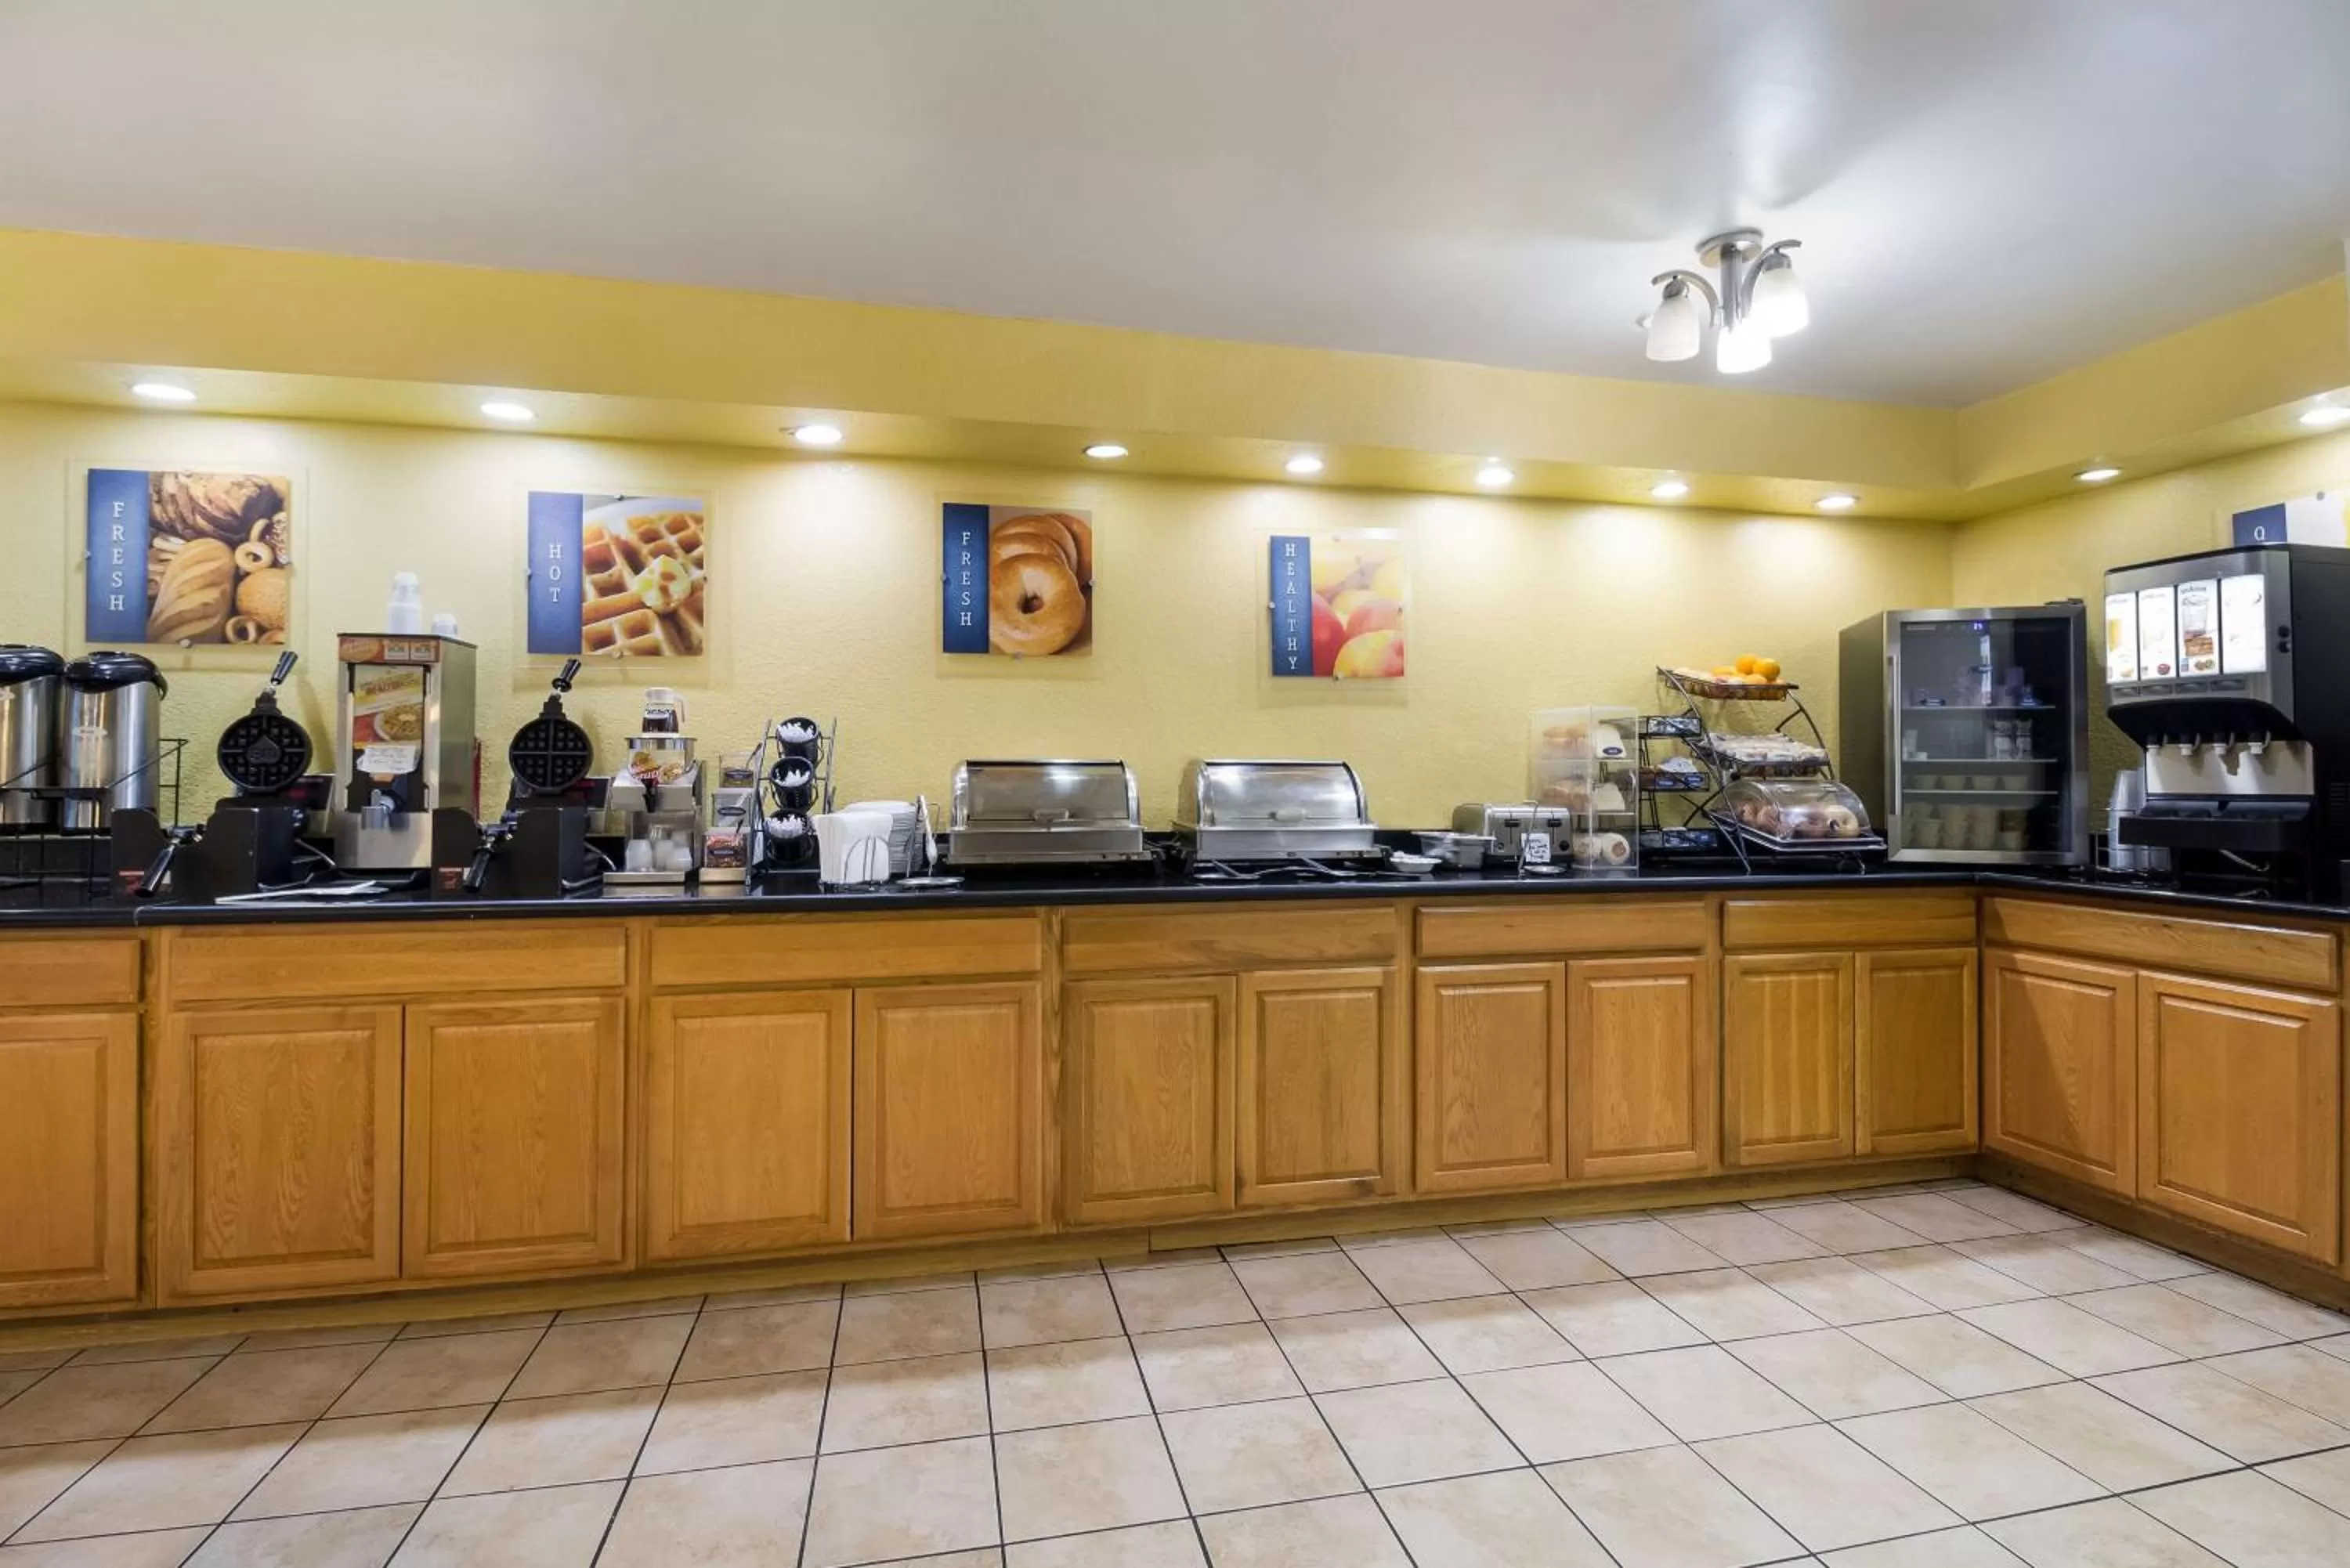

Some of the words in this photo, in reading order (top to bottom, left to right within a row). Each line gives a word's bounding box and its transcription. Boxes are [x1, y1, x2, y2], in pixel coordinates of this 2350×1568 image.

[110, 501, 125, 611] FRESH
[548, 544, 562, 602] HOT
[960, 532, 971, 626] FRESH
[1285, 543, 1298, 669] HEALTHY
